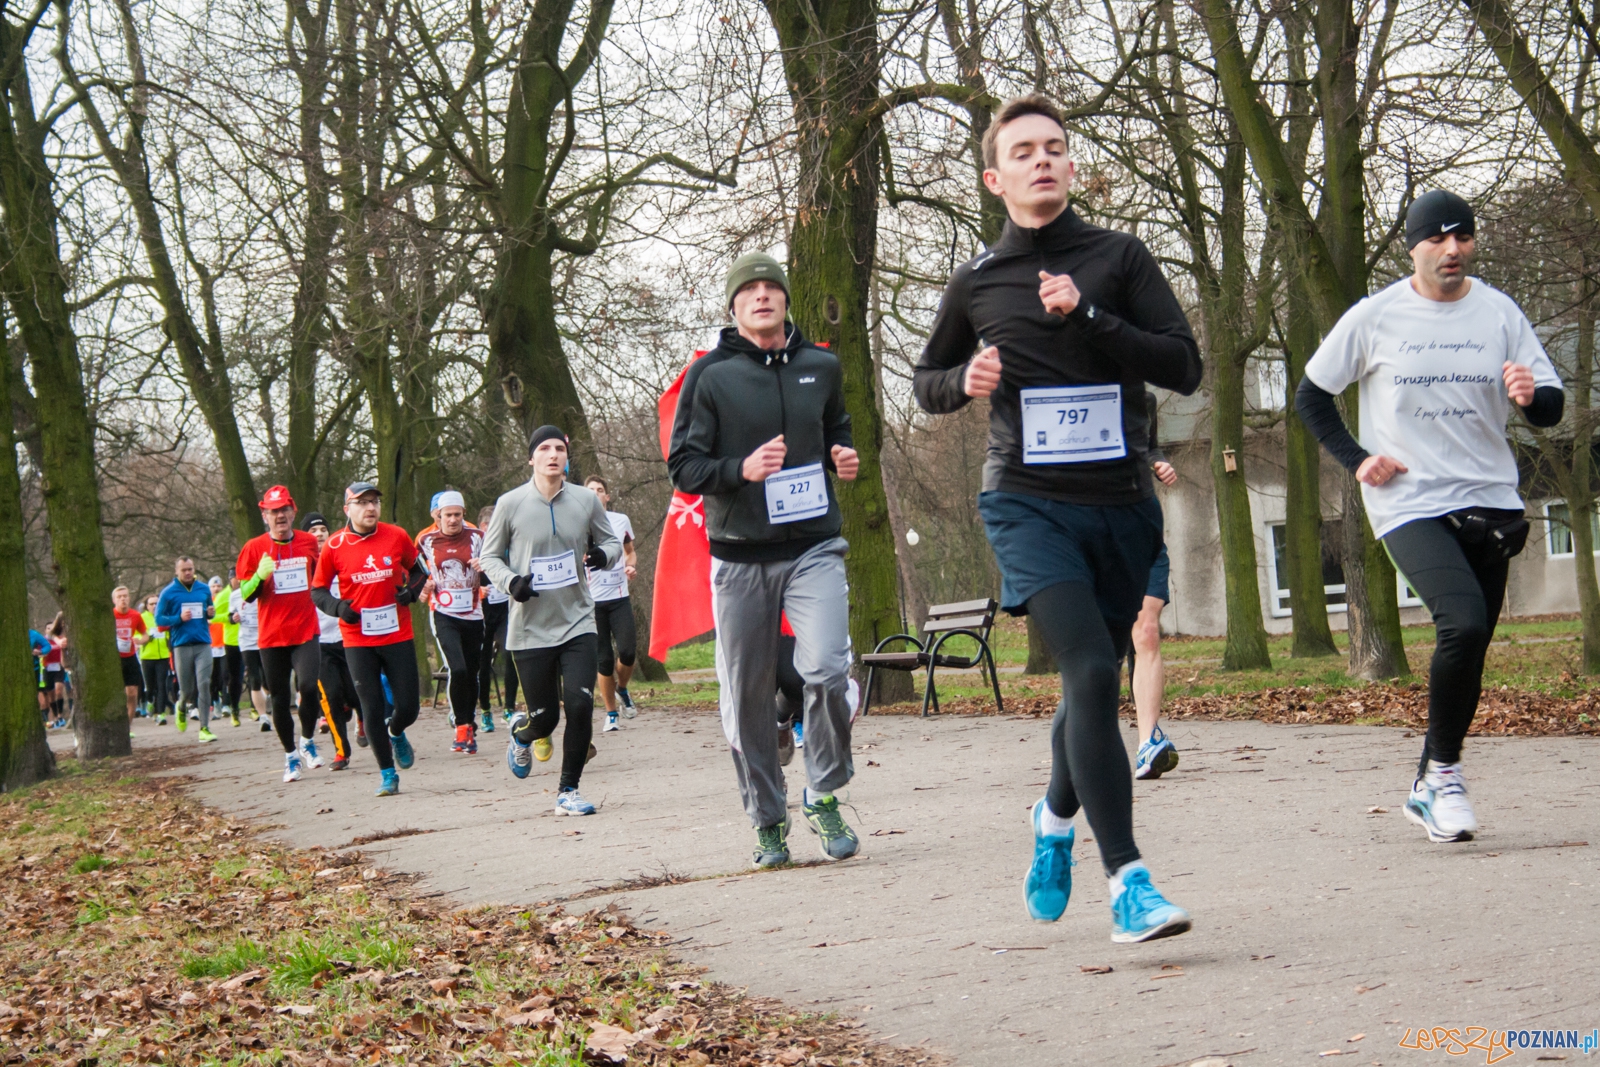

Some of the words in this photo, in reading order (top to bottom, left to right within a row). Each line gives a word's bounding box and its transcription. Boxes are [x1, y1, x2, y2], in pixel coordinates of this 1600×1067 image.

[1398, 341, 1407, 352] Z
[1428, 340, 1436, 349] do
[1056, 408, 1089, 425] 797
[1414, 407, 1422, 417] Z
[1442, 407, 1450, 416] do
[1059, 434, 1090, 445] parkrun
[789, 481, 810, 495] 227
[548, 562, 563, 572] 814
[375, 613, 388, 621] 264
